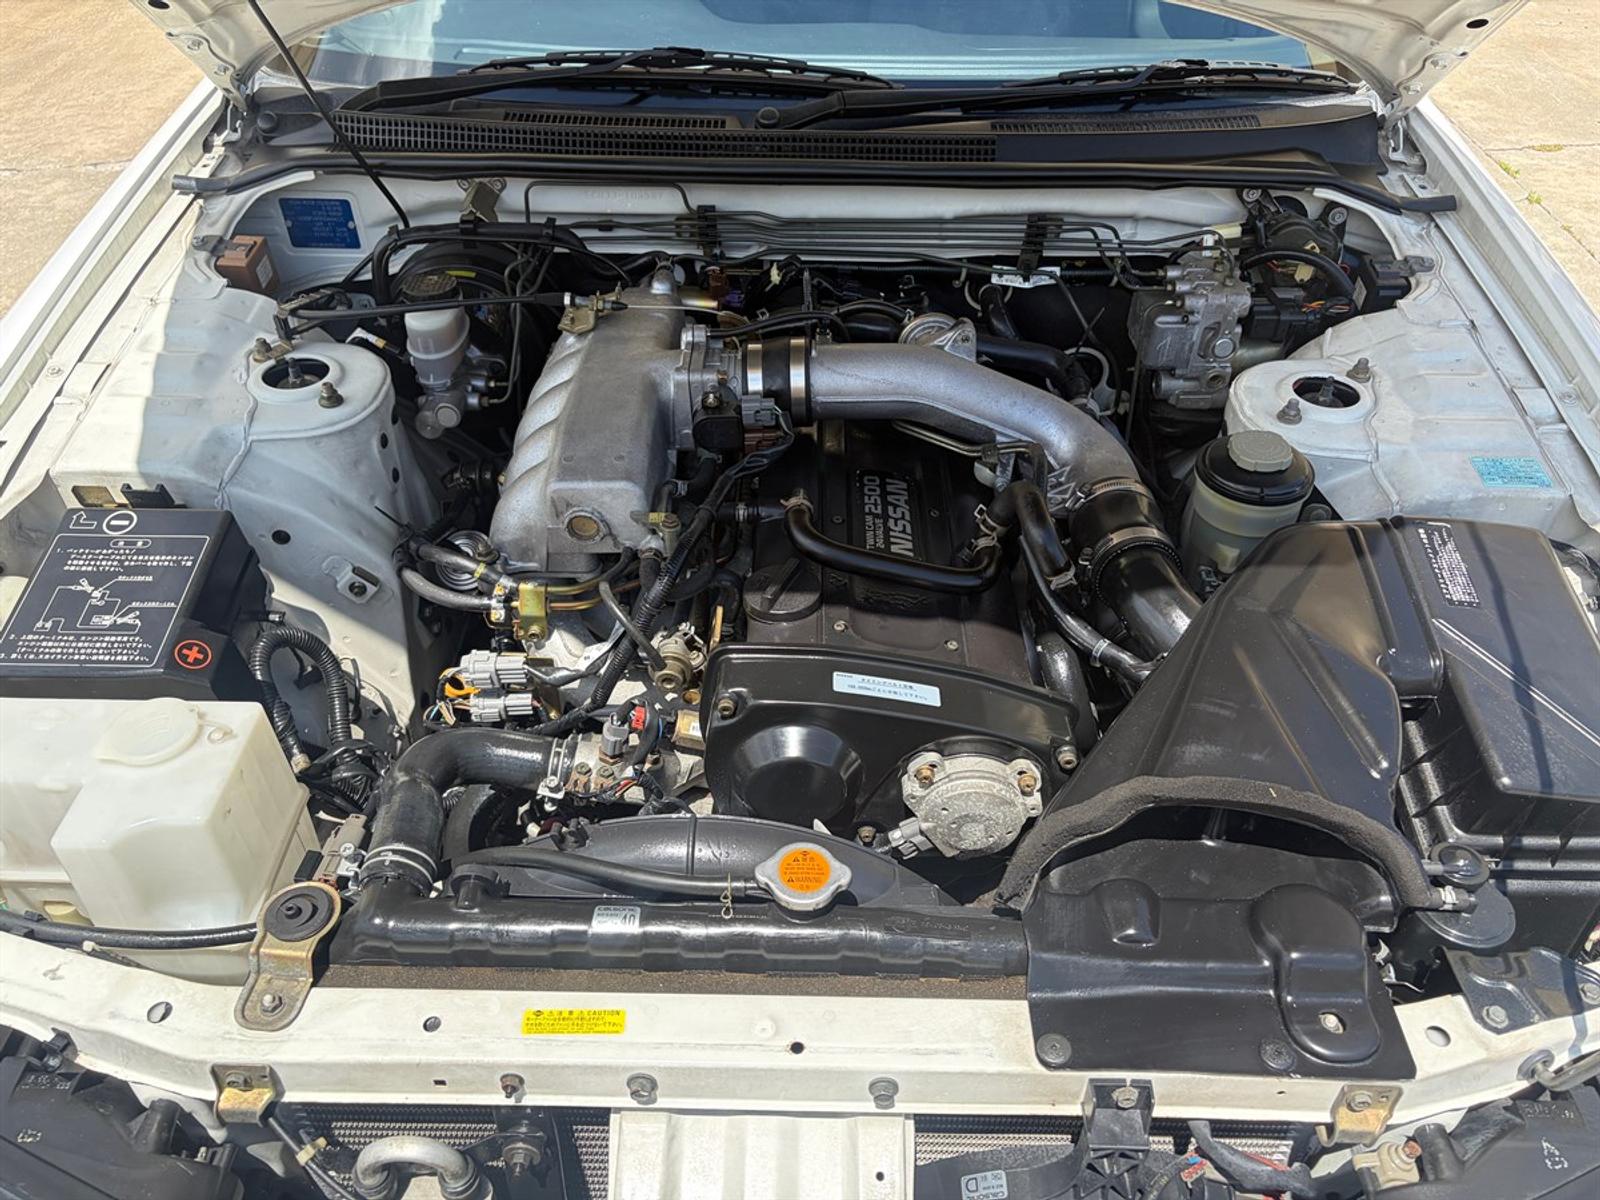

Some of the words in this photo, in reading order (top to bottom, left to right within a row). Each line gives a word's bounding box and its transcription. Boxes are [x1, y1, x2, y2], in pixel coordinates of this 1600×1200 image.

[863, 475, 882, 514] 2500
[865, 514, 874, 530] CAM
[886, 478, 914, 557] NISSAN
[865, 531, 875, 550] TWIN
